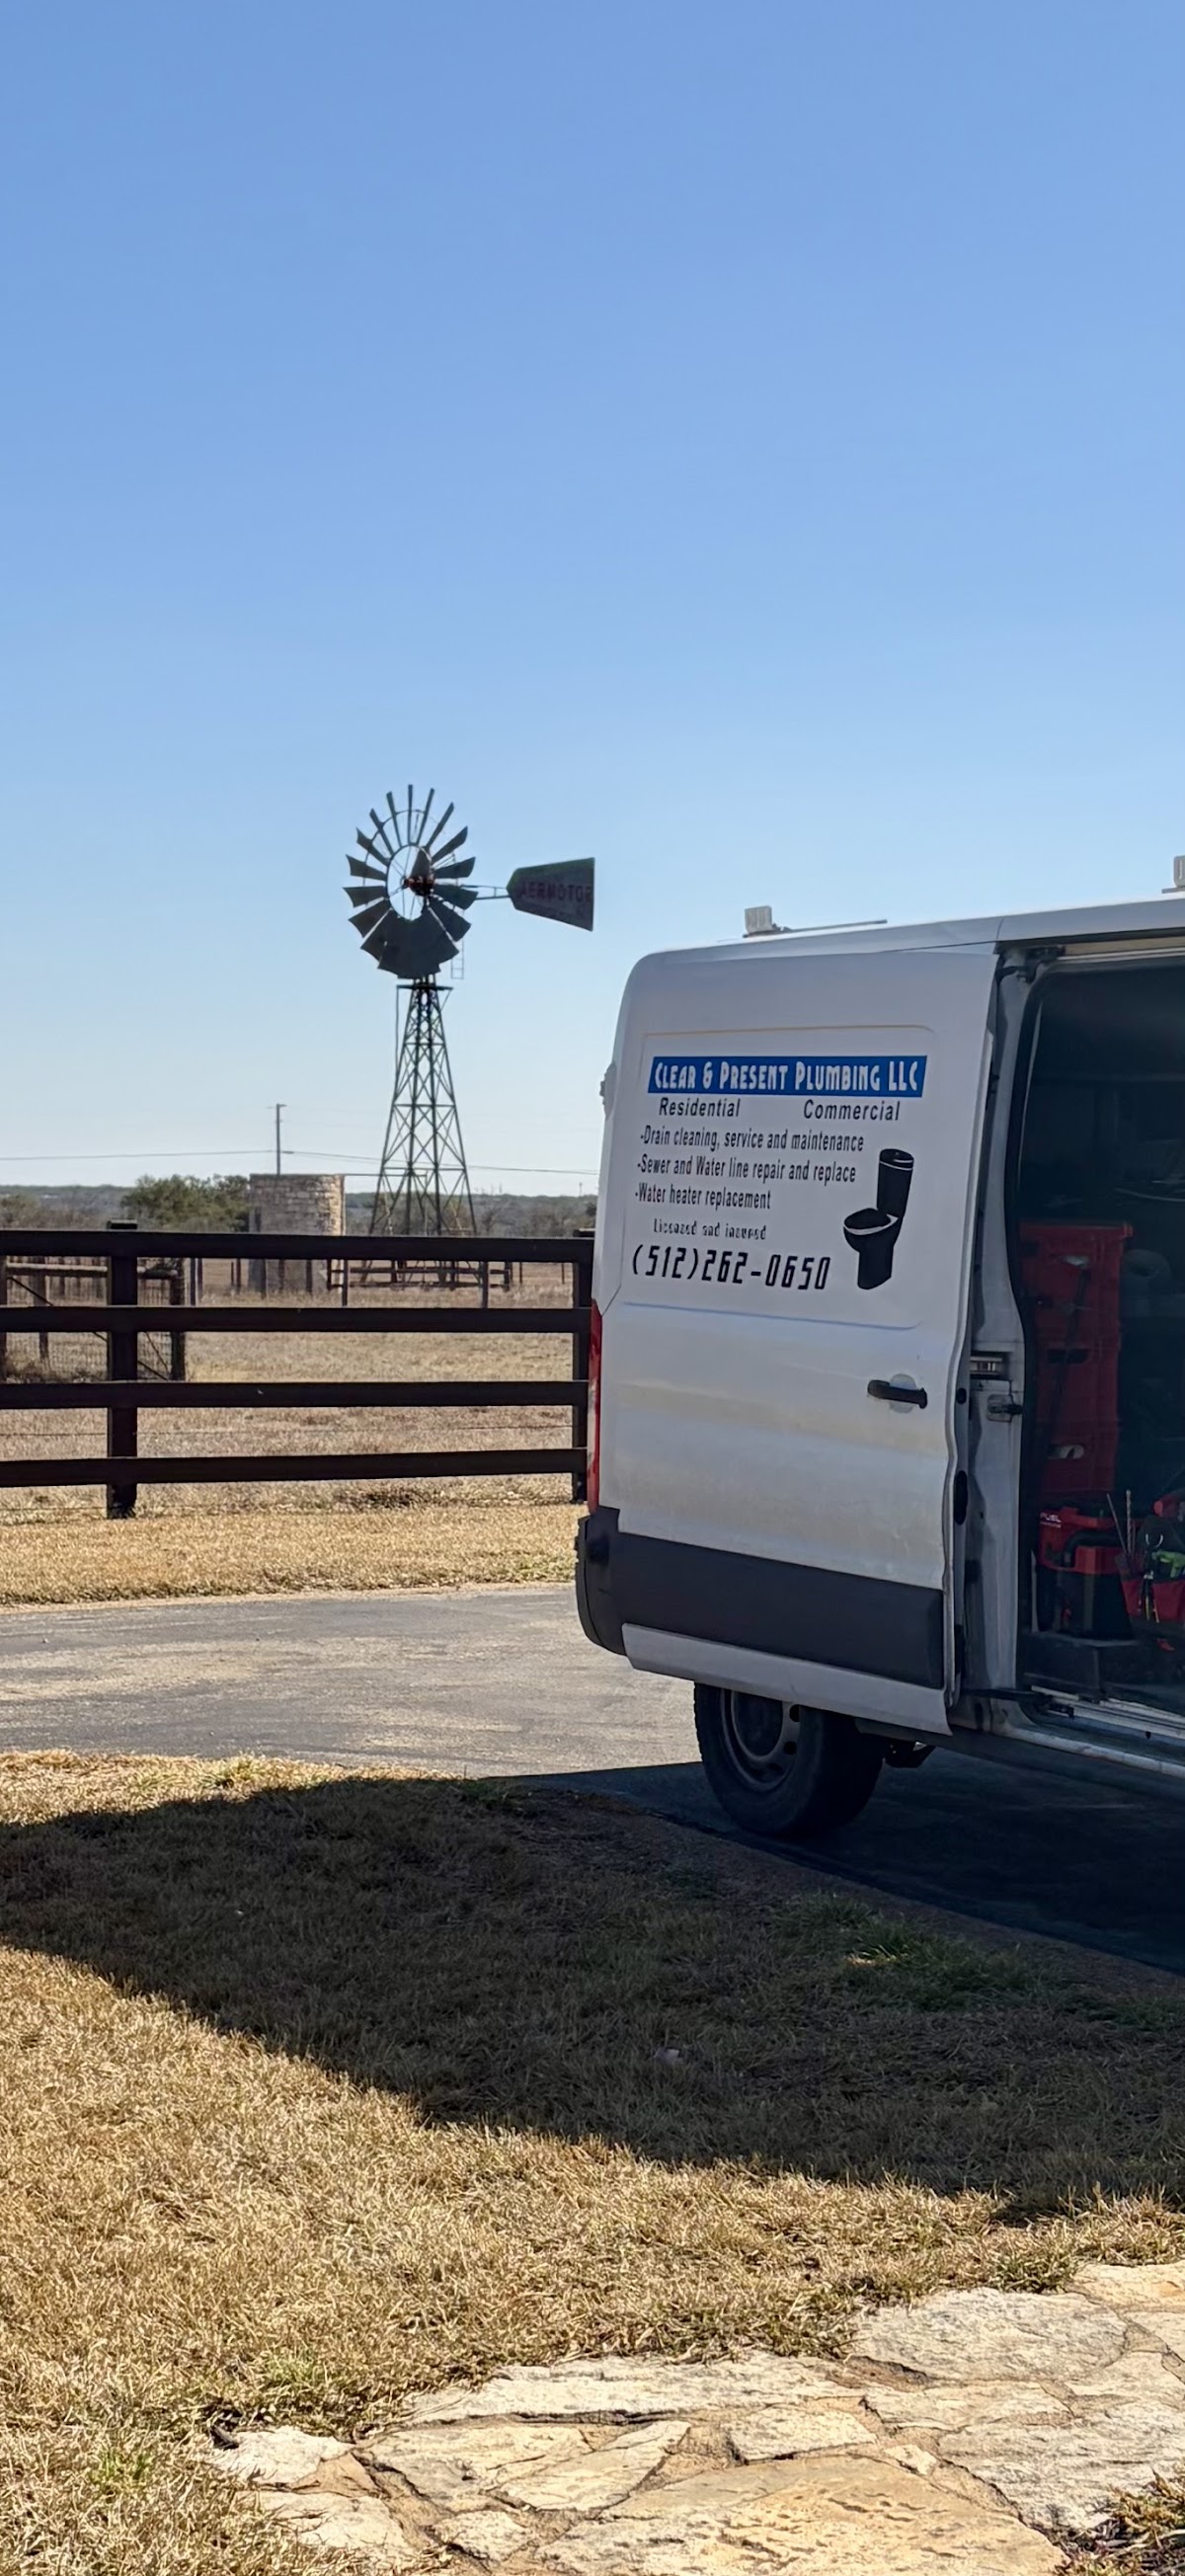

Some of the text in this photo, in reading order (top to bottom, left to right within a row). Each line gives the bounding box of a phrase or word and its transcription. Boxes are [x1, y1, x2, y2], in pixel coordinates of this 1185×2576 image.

[702, 1061, 713, 1088] &
[719, 1062, 789, 1090] PRESENT
[888, 1060, 918, 1091] LLC
[659, 1097, 742, 1117] Residential
[803, 1099, 901, 1121] Commercial
[640, 1125, 864, 1152] -Drain cleaning, service and maintenance
[637, 1153, 856, 1186] -Sewer and Water line repair and replace
[635, 1182, 771, 1211] -Water heater replacement
[632, 1244, 831, 1290] (512)262-0650
